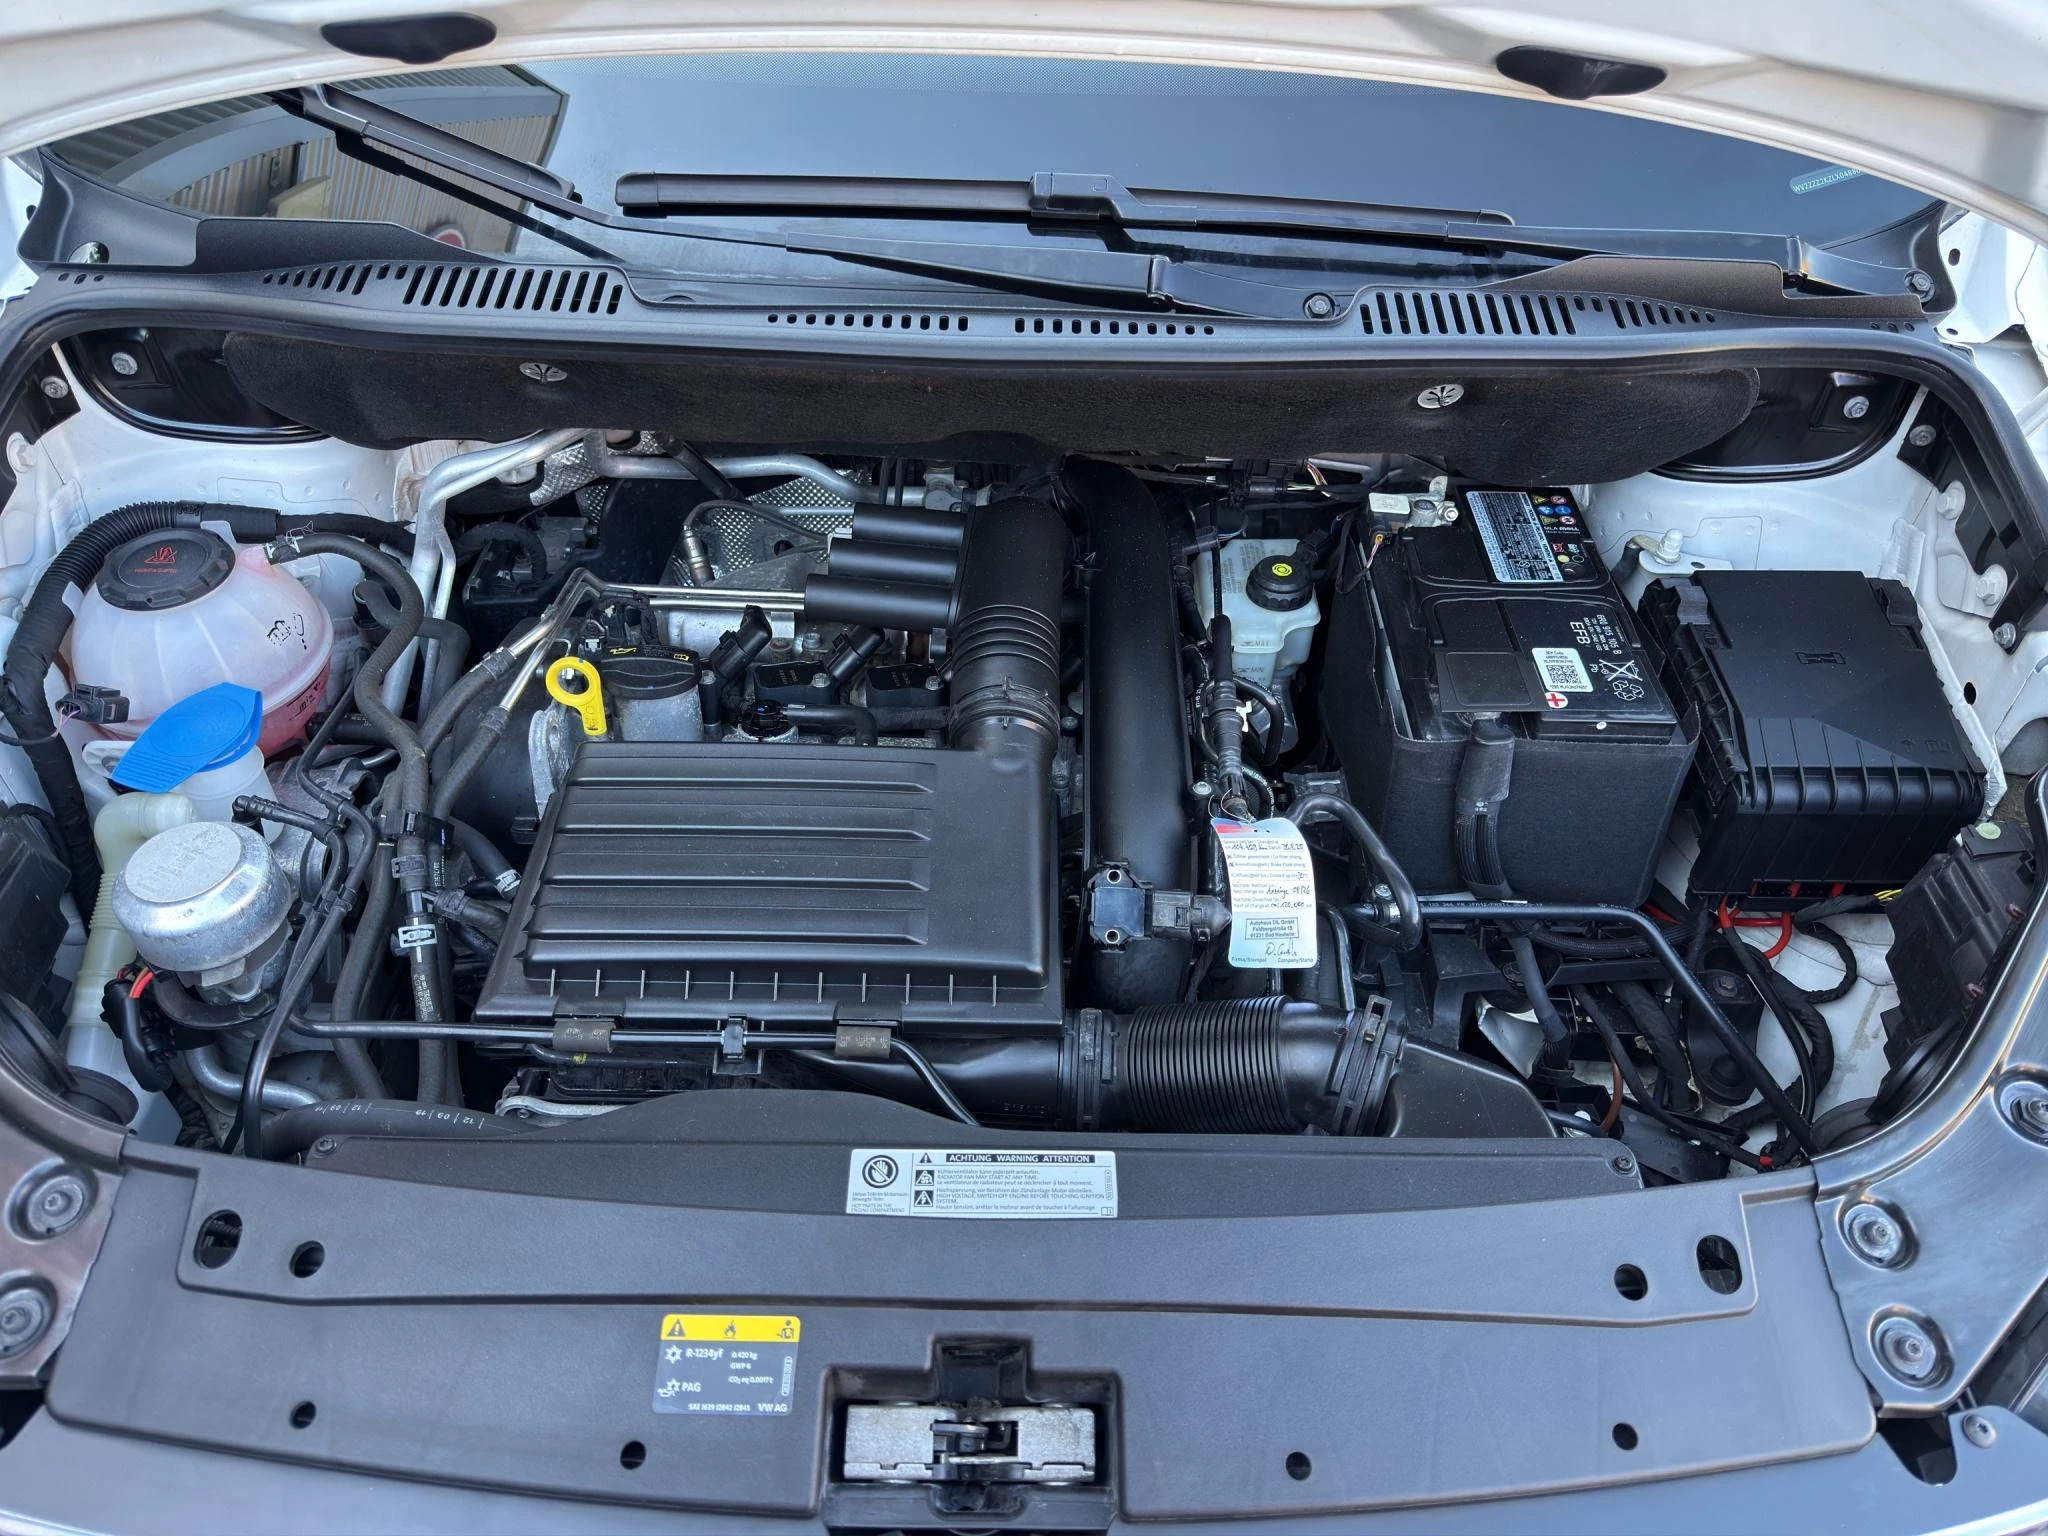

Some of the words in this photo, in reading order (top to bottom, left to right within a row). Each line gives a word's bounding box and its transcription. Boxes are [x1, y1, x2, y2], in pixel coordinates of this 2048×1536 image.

[1569, 621, 1591, 644] EFB
[1608, 638, 1620, 649] 105
[1588, 663, 1599, 673] Pb
[949, 1154, 992, 1162] ACHTUNG
[996, 1154, 1039, 1163] WARNING
[1042, 1155, 1091, 1163] ATTENTION
[685, 1348, 725, 1361] R-1234yf
[681, 1381, 702, 1392] PAG
[757, 1402, 774, 1413] VW
[774, 1402, 789, 1413] AG
